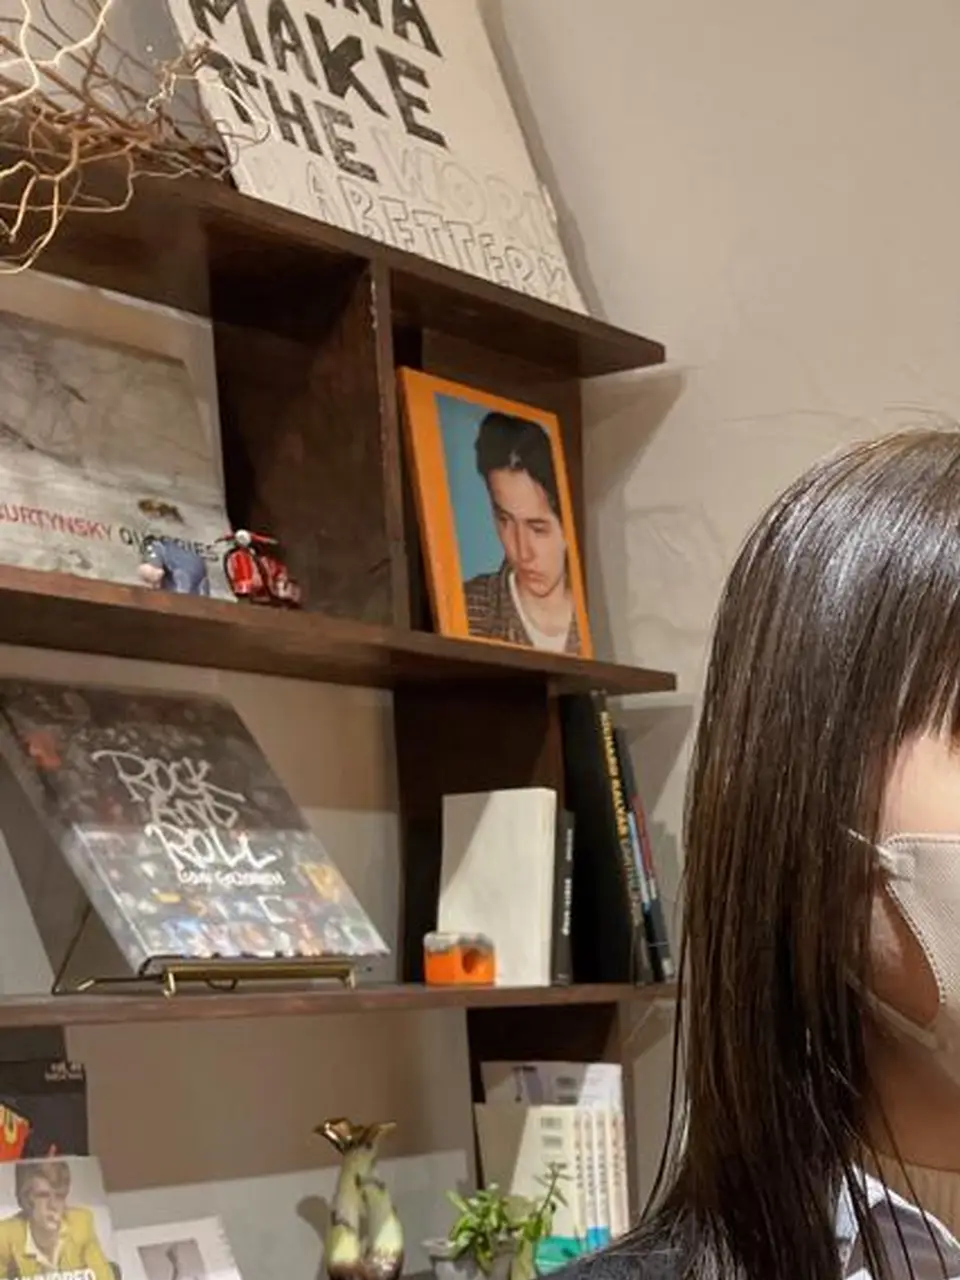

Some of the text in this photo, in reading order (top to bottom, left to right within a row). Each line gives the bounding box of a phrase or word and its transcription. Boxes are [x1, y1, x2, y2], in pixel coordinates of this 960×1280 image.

[188, 0, 450, 149] MAKE
[203, 48, 379, 183] THE
[0, 503, 113, 541] URTYNSKY
[91, 750, 247, 802] ROCK
[144, 823, 284, 868] ROLL
